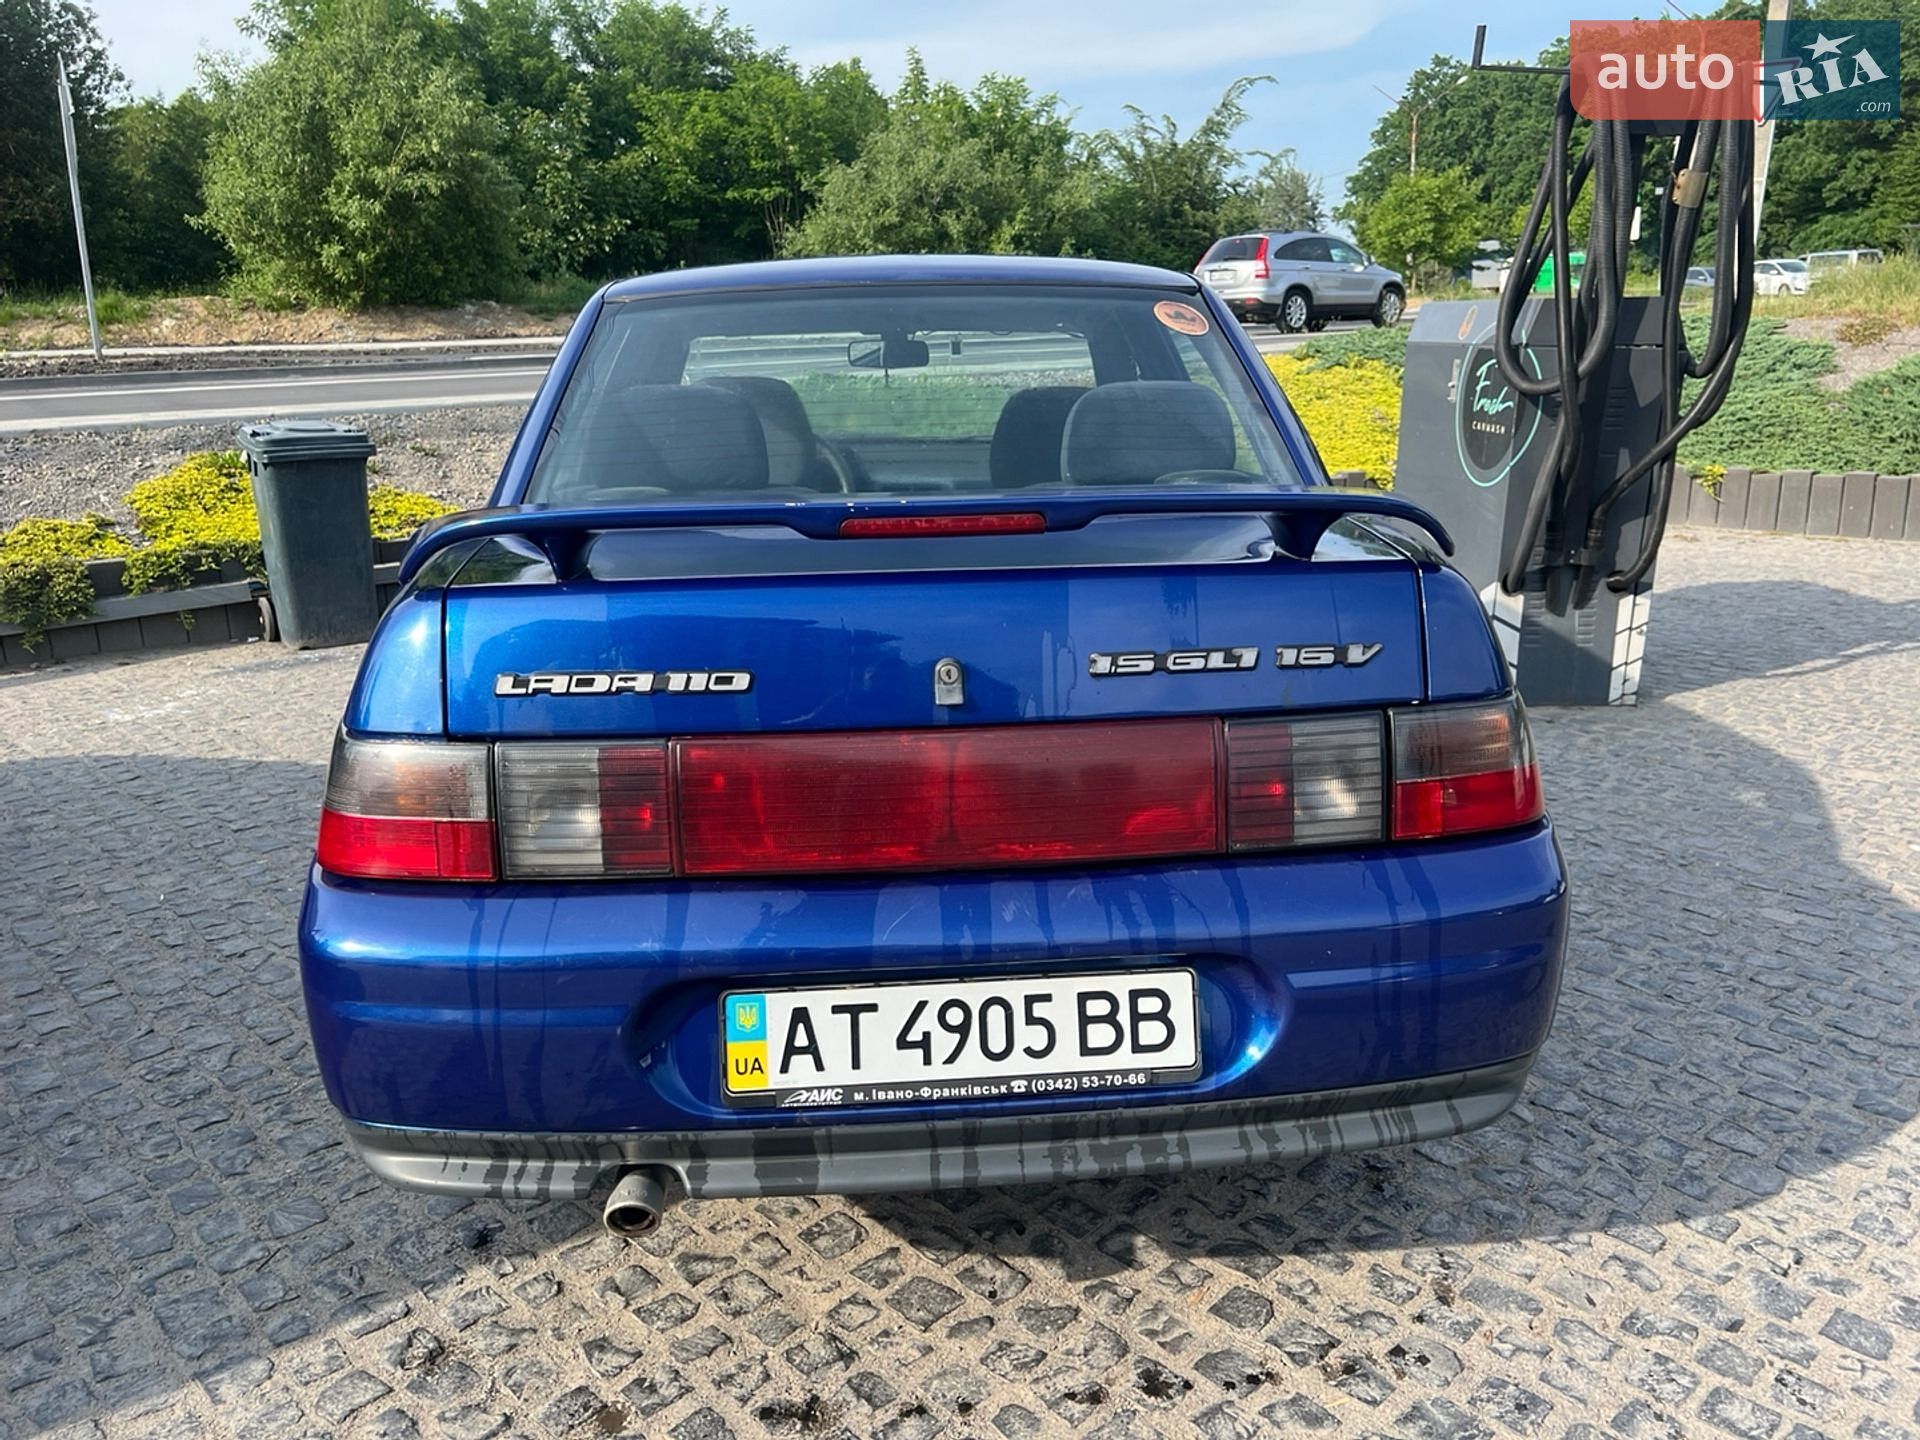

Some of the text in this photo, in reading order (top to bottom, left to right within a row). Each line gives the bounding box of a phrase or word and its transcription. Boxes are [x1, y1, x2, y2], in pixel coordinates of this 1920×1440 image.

[495, 671, 751, 695] LADA 110
[779, 988, 1176, 1074] AT 4905 BB
[735, 1056, 765, 1076] UA
[872, 1084, 1008, 1101] Івано-Франківськ
[1031, 1077, 1078, 1094] (0342)
[1081, 1072, 1147, 1089] 53-70-66
